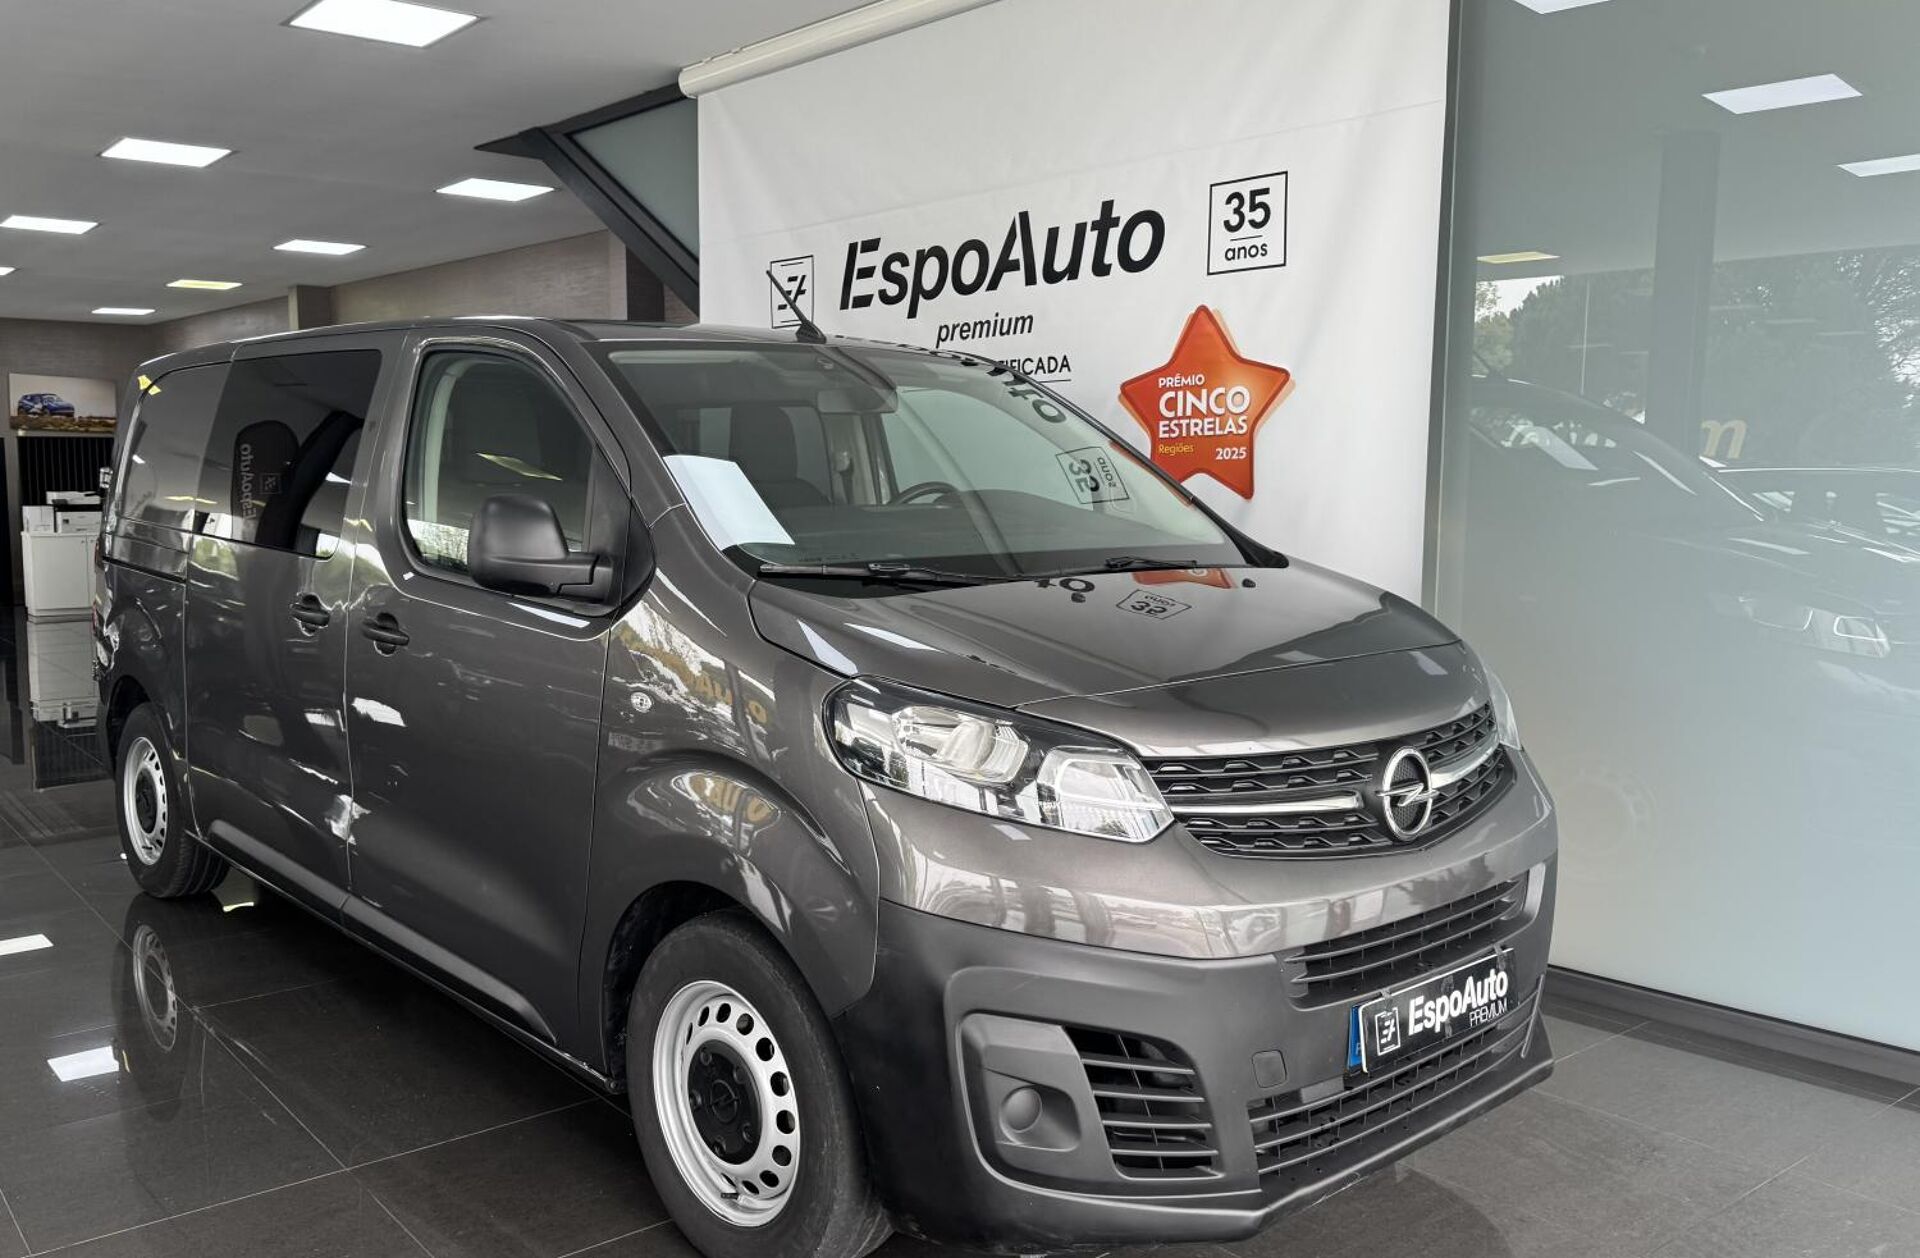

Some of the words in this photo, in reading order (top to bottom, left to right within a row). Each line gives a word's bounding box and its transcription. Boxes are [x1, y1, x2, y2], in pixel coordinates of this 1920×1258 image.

[1223, 187, 1271, 233] 35
[839, 199, 1166, 320] EspoAuto
[1224, 243, 1268, 261] anos
[935, 312, 1034, 349] premium
[1158, 373, 1205, 388] PRÉMIO
[1159, 386, 1251, 418] CINCO
[1158, 416, 1248, 438] ESTRELAS
[1158, 442, 1194, 456] Regiões
[1215, 447, 1248, 460] 2025
[1408, 968, 1509, 1036] EspoAuto
[1468, 998, 1508, 1028] PREMIUM
